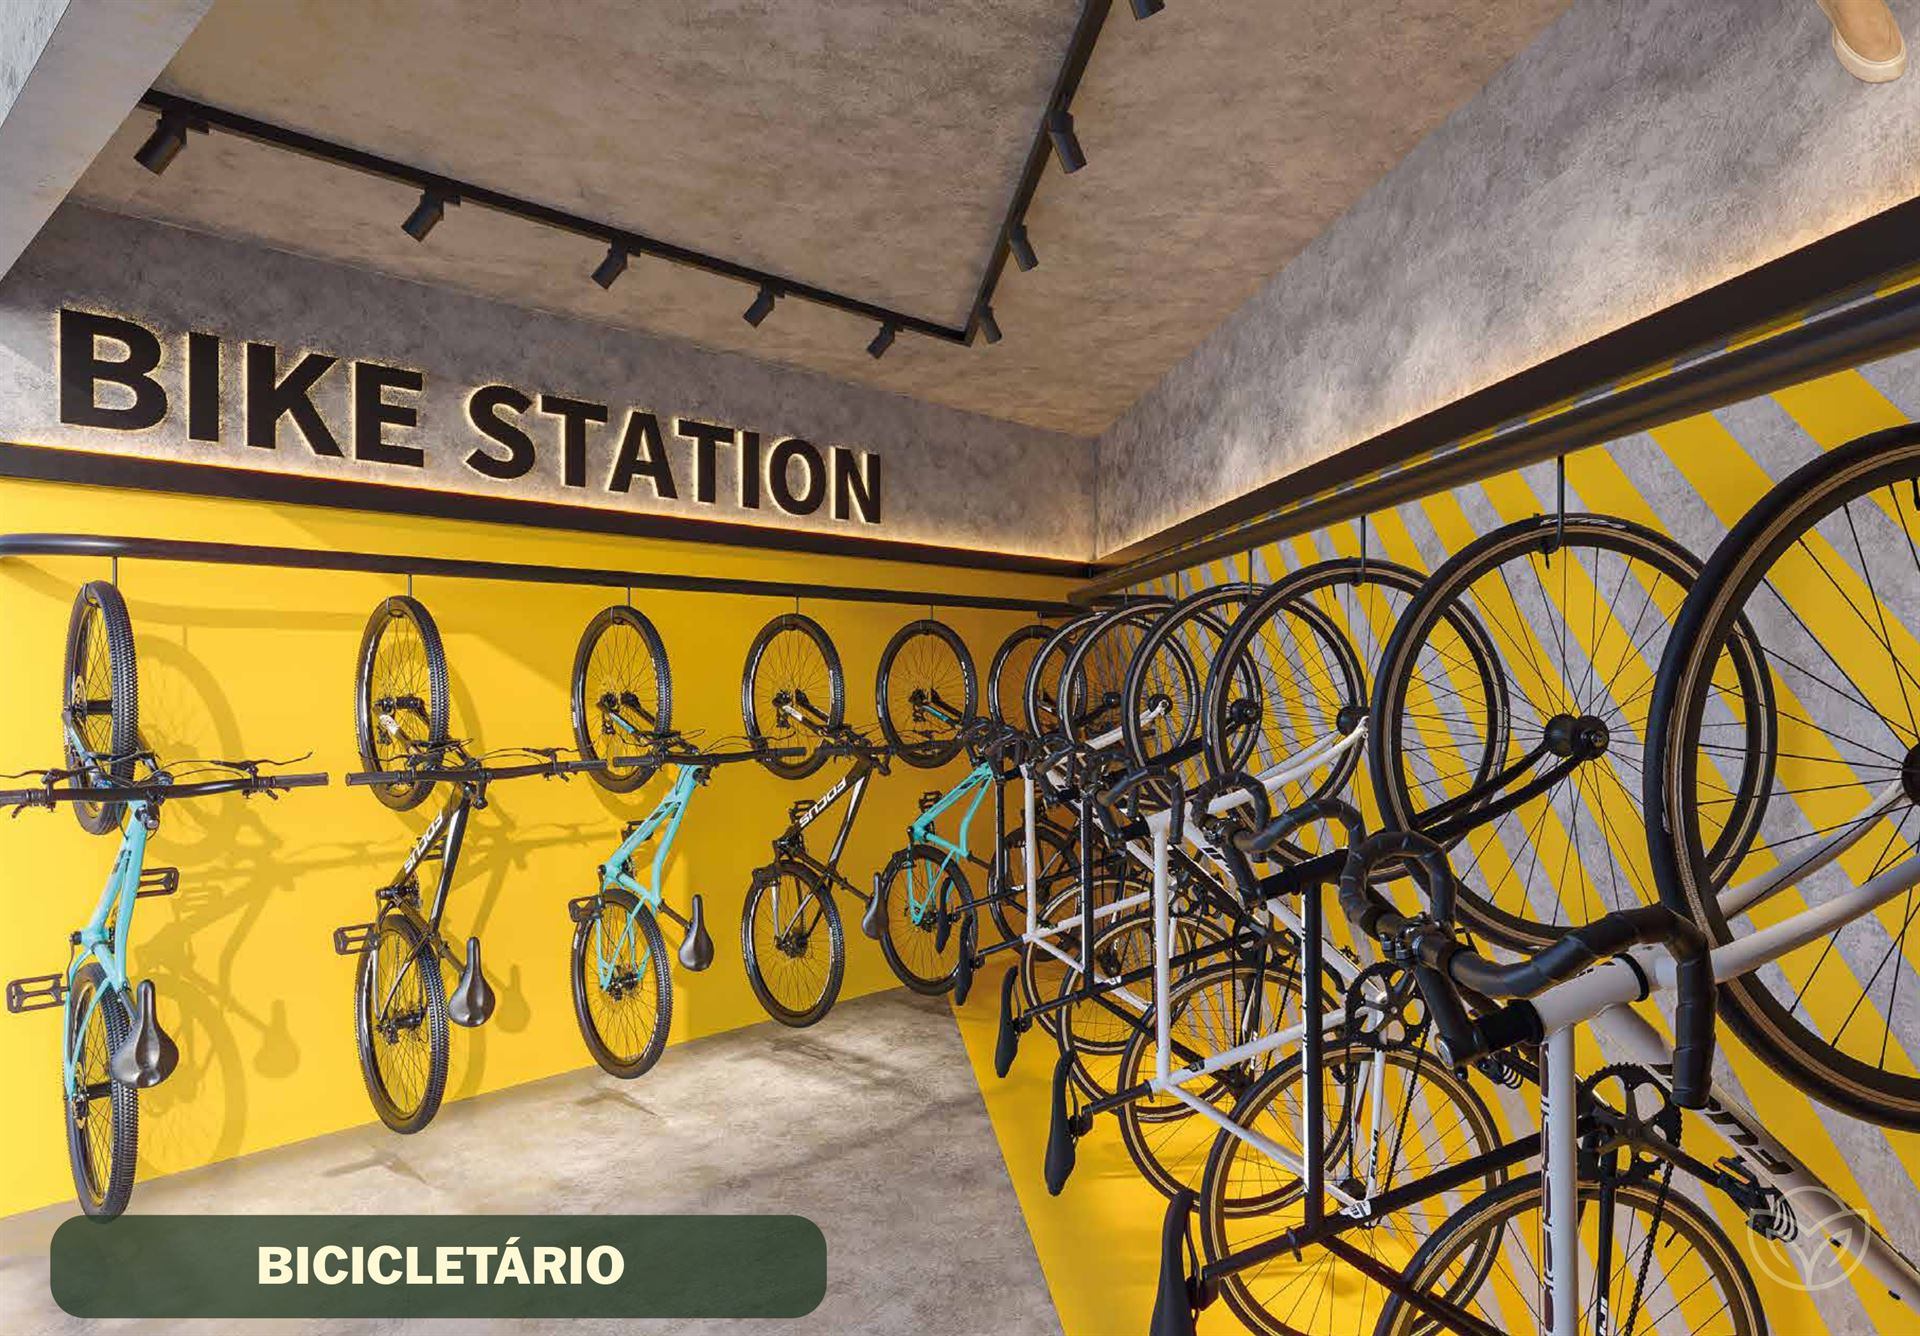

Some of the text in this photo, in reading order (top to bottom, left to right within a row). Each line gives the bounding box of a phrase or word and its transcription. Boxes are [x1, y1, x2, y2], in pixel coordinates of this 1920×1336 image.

[59, 308, 882, 525] BIKE STATION
[798, 775, 847, 828] FOCUS
[403, 808, 443, 874] FOCUS
